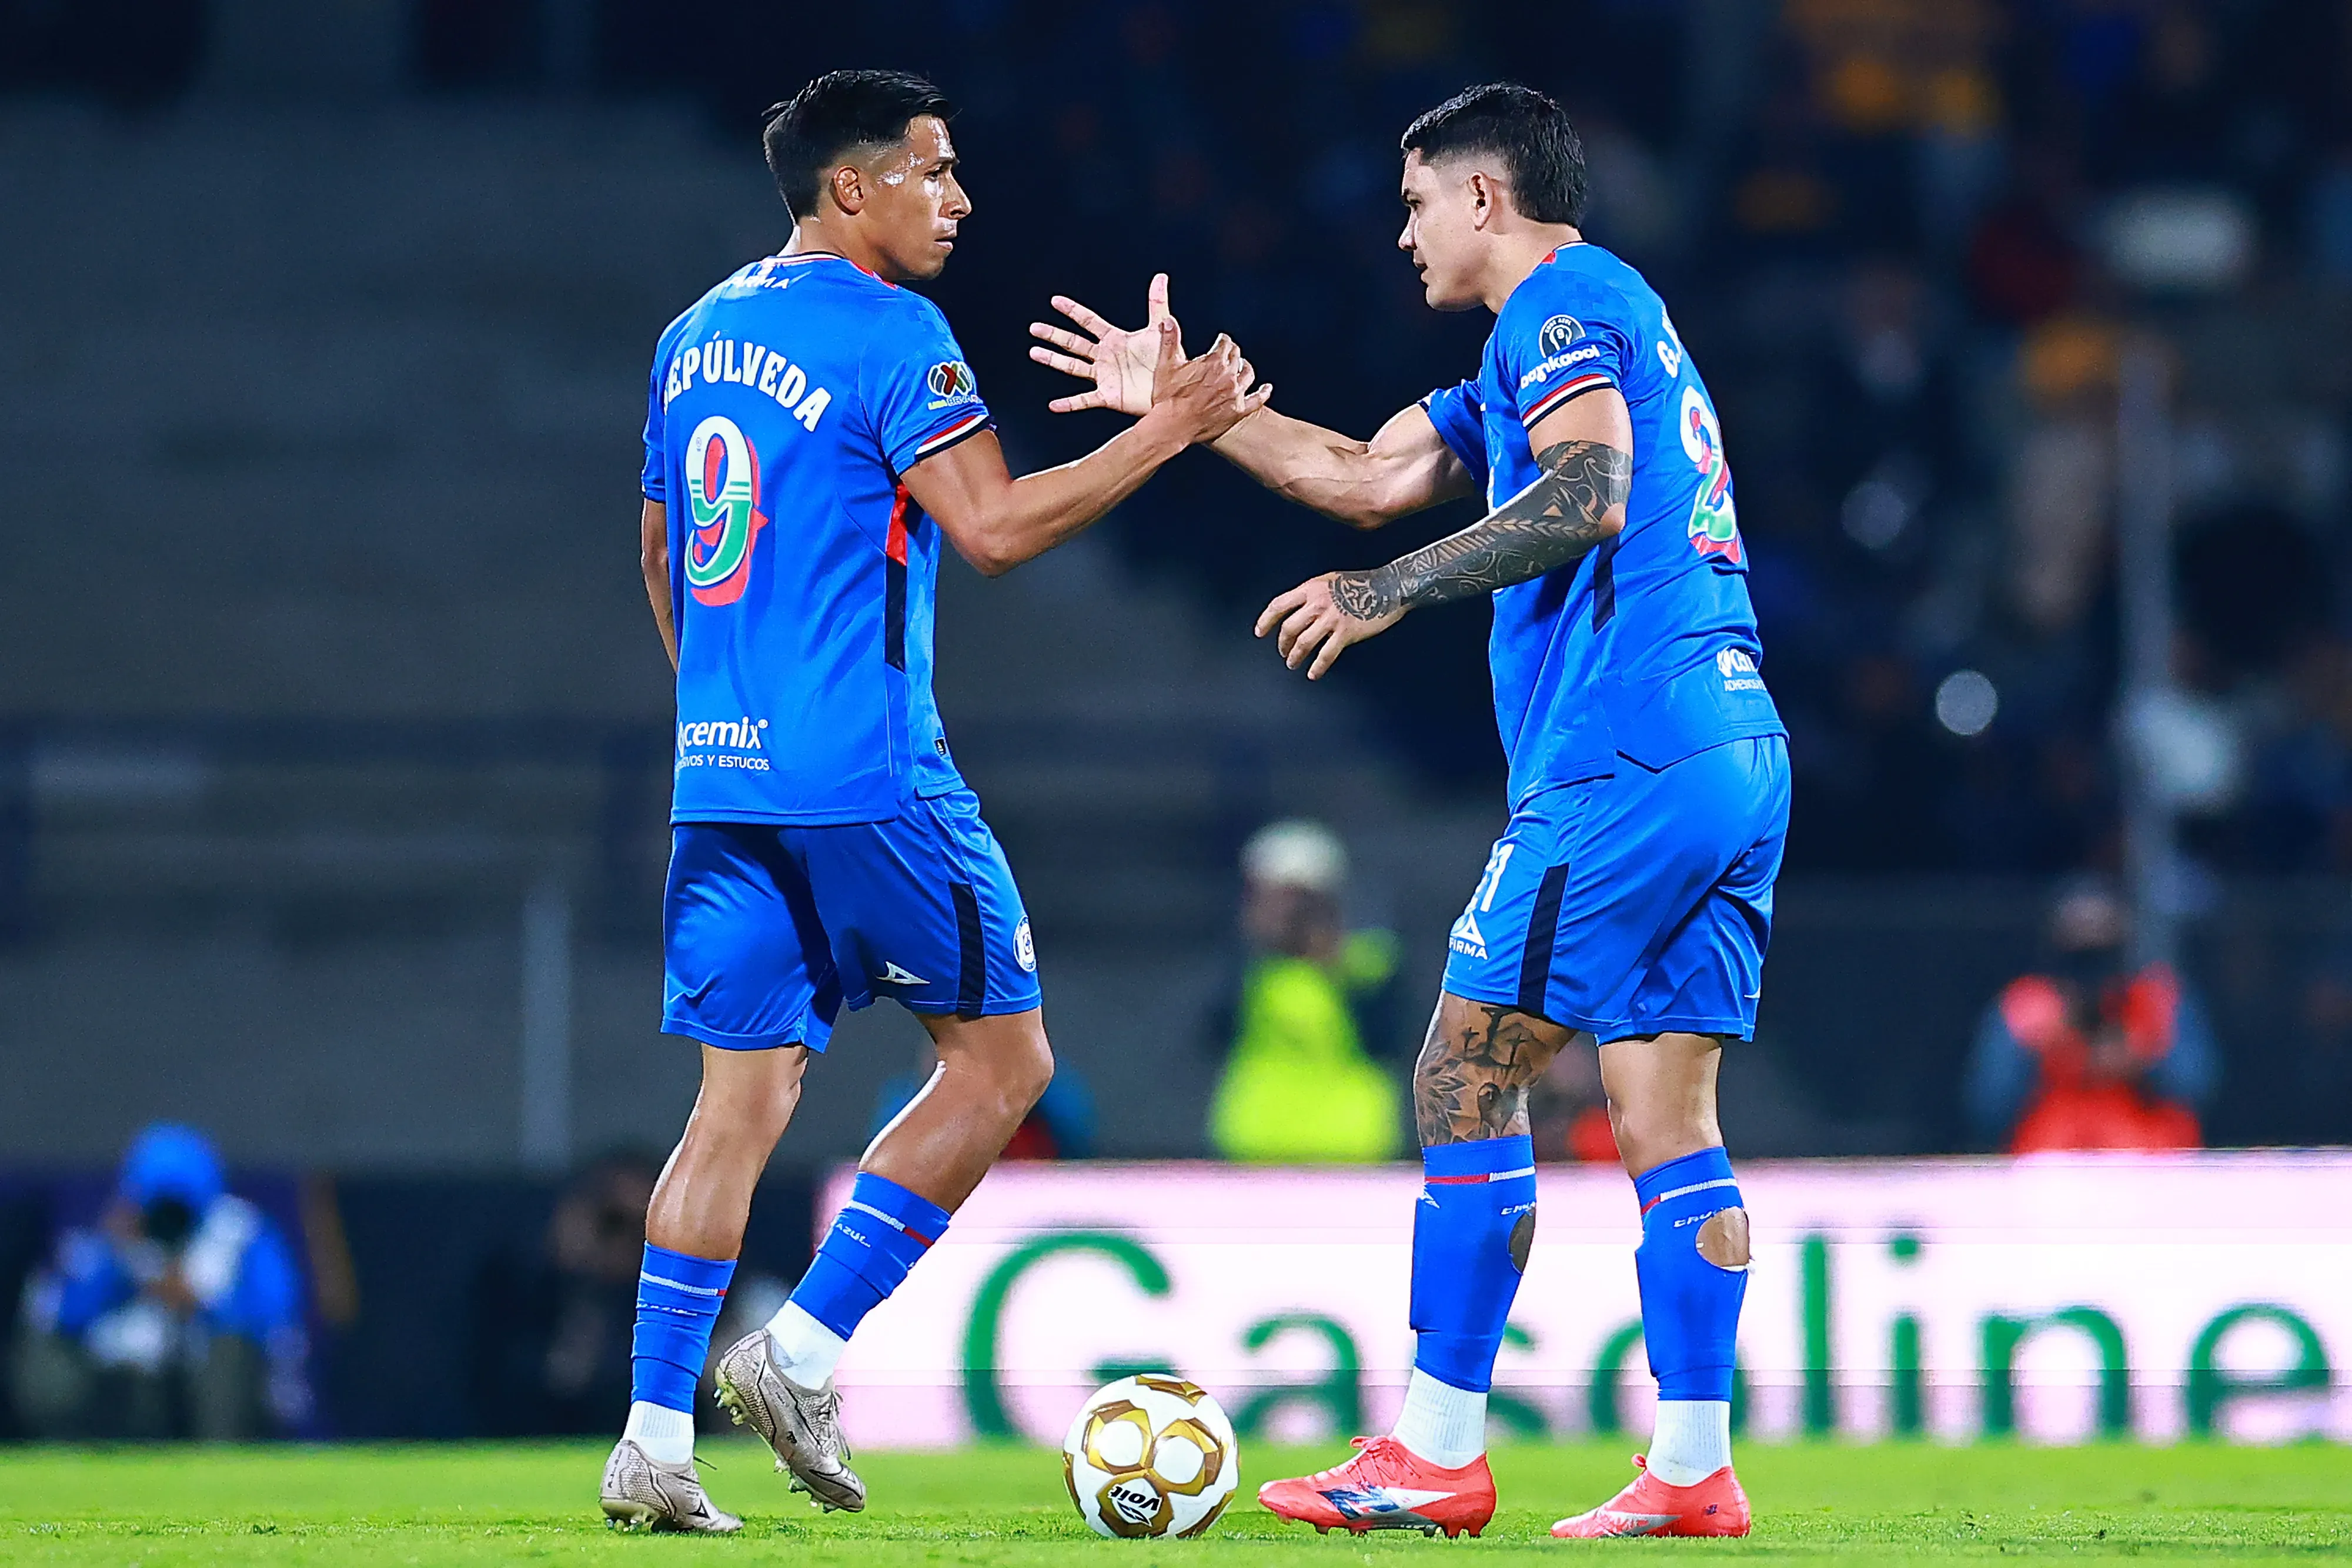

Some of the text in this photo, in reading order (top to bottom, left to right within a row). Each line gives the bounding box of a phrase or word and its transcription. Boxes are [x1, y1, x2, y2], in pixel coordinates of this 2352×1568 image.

[1556, 328, 1565, 339] 9
[685, 416, 759, 594] 9
[707, 755, 715, 766] Y
[719, 755, 770, 771] ESTUCOS
